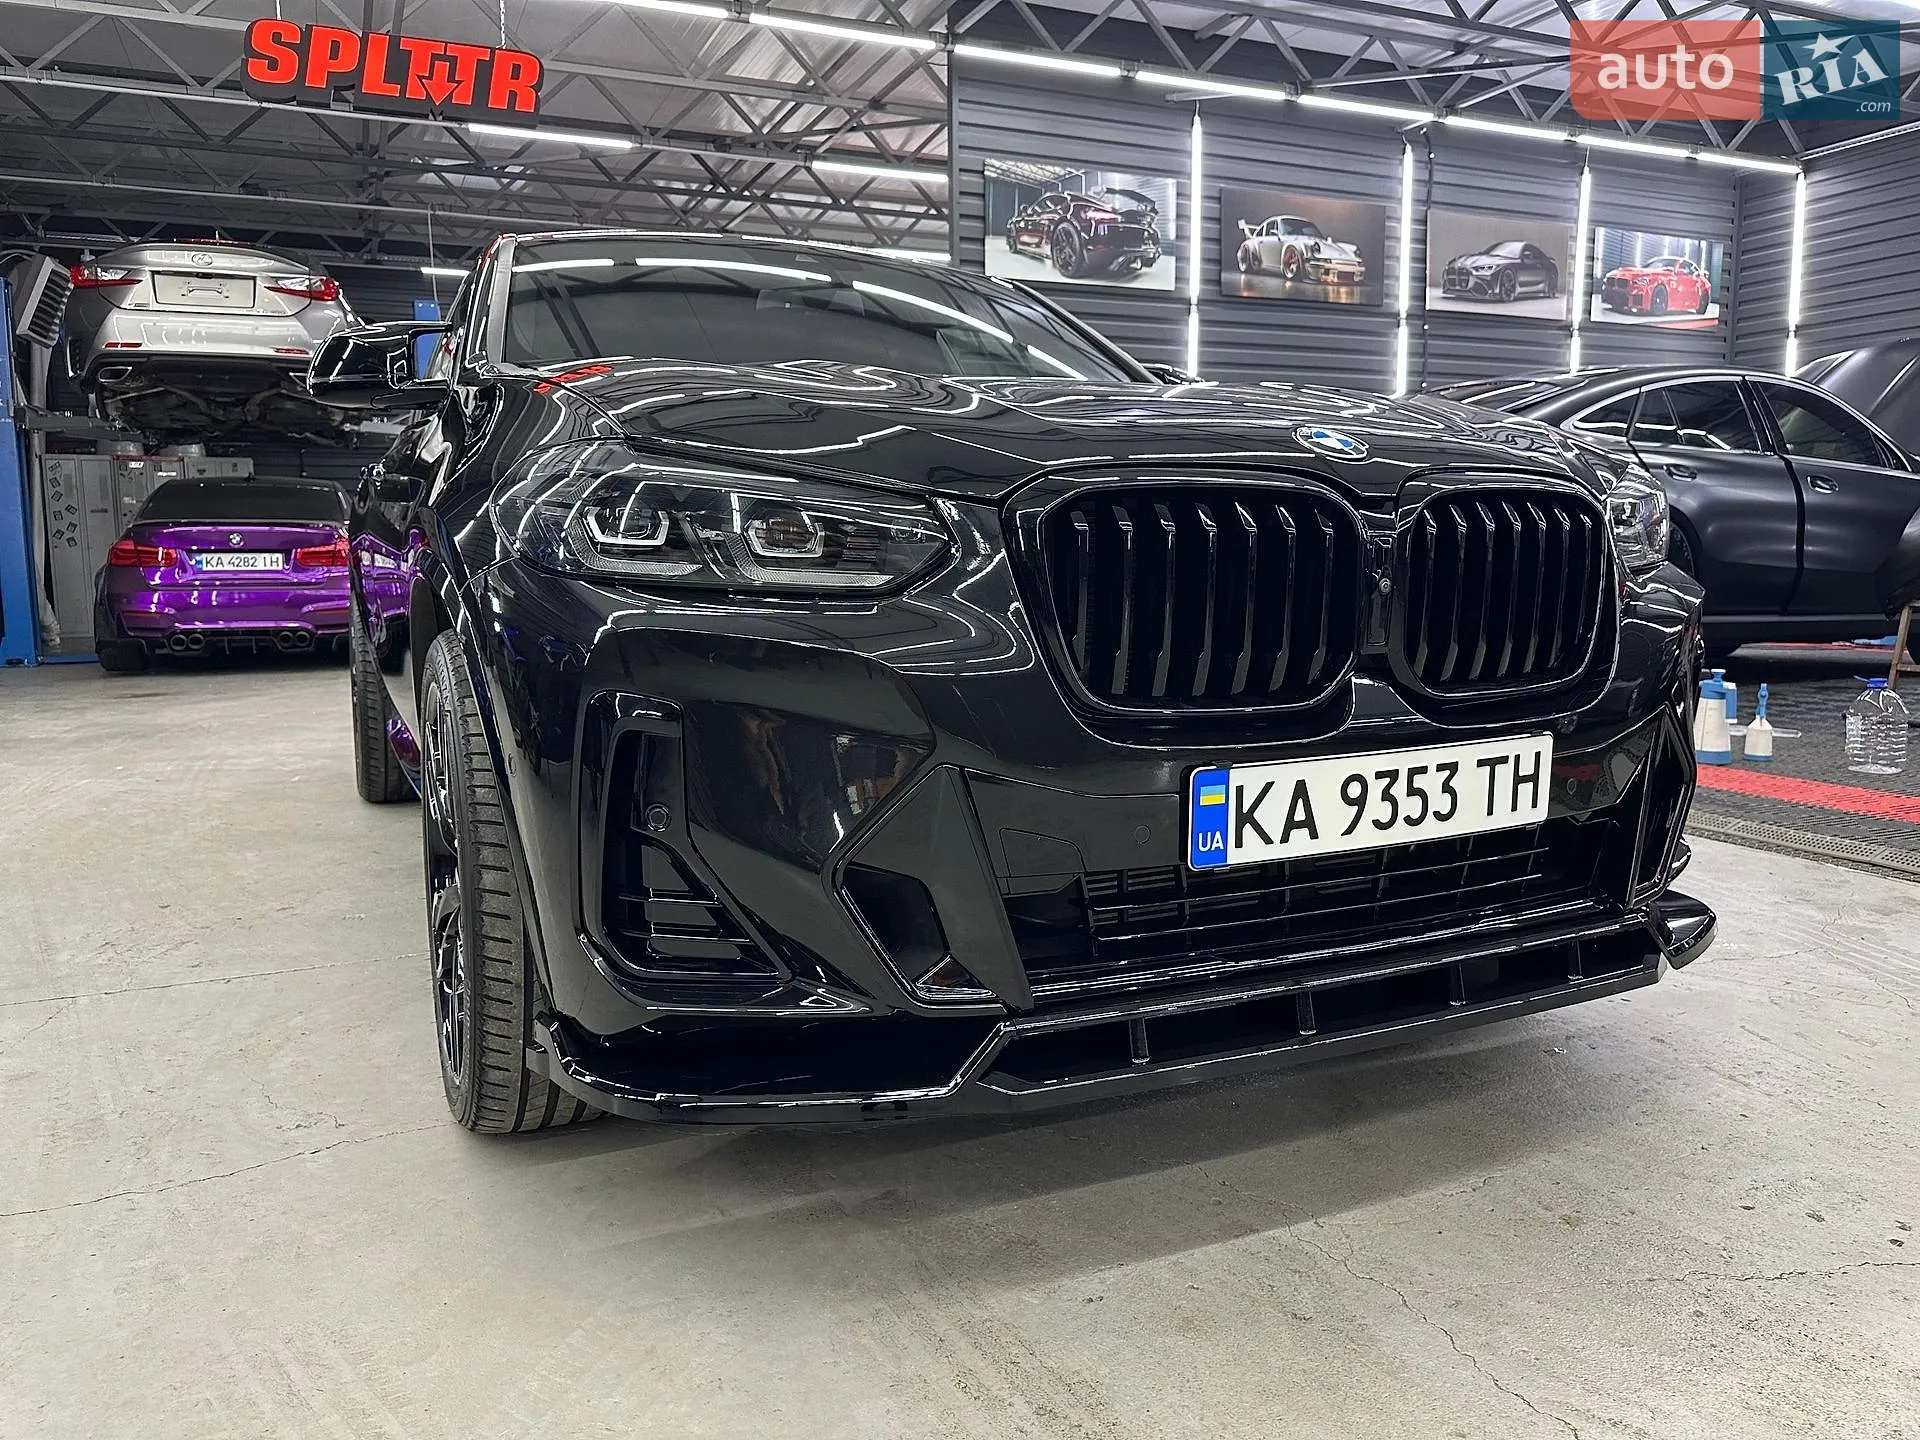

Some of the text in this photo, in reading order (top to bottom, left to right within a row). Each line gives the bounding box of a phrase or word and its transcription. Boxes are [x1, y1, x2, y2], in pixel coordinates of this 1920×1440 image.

[205, 556, 225, 568] KA
[228, 556, 257, 568] 4282
[1234, 750, 1541, 849] KA 9353 TH
[1198, 830, 1224, 852] UA
